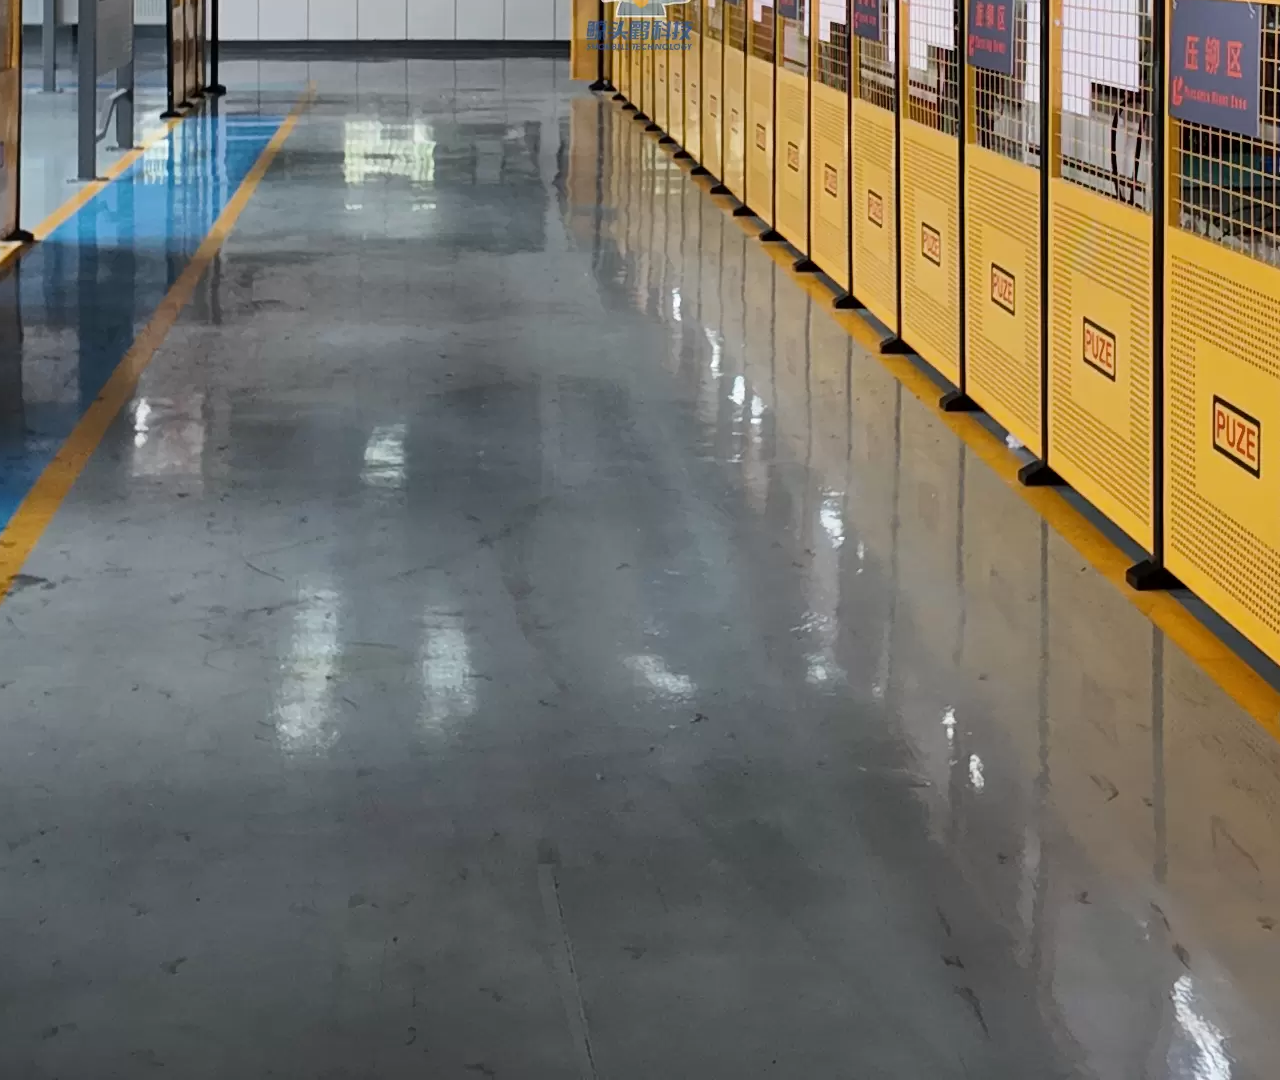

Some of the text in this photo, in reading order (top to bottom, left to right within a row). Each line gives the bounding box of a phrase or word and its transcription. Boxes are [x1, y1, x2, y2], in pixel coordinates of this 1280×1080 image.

[993, 272, 1014, 306] PUZE
[1085, 328, 1113, 369] PUZE
[1217, 409, 1256, 463] PUZE
